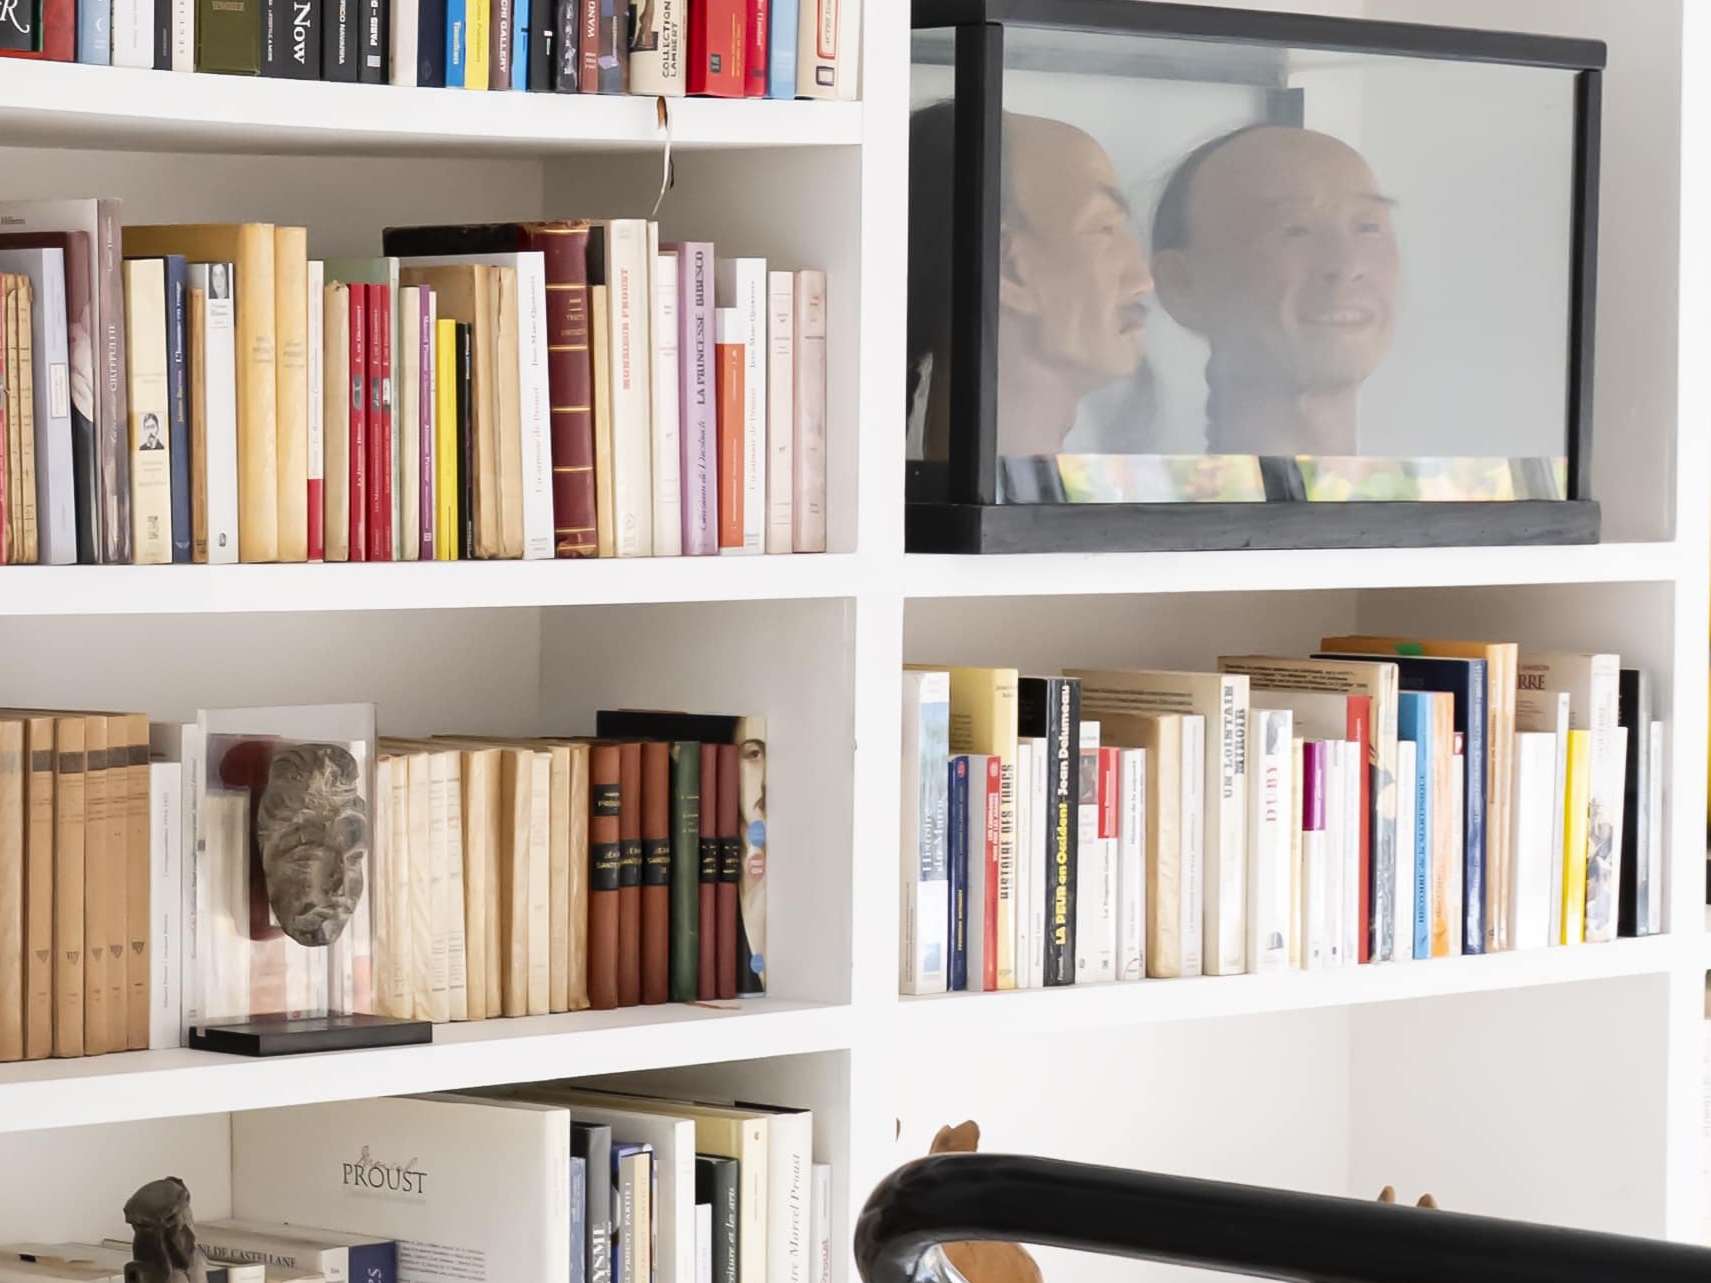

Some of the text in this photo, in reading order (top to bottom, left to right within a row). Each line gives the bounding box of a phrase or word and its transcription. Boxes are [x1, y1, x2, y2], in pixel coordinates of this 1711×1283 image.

[293, 2, 311, 64] Now
[661, 0, 672, 79] COLLECTION
[695, 250, 706, 406] LA PRINCESSE BIBESCO
[1058, 684, 1070, 758] Delumeau
[1223, 685, 1234, 799] UN LOINTAIN
[1234, 708, 1246, 775] MIROIR
[1058, 763, 1069, 796] Jean
[1055, 886, 1067, 926] PEUR
[1055, 929, 1065, 946] LA
[342, 1163, 428, 1195] PROUST
